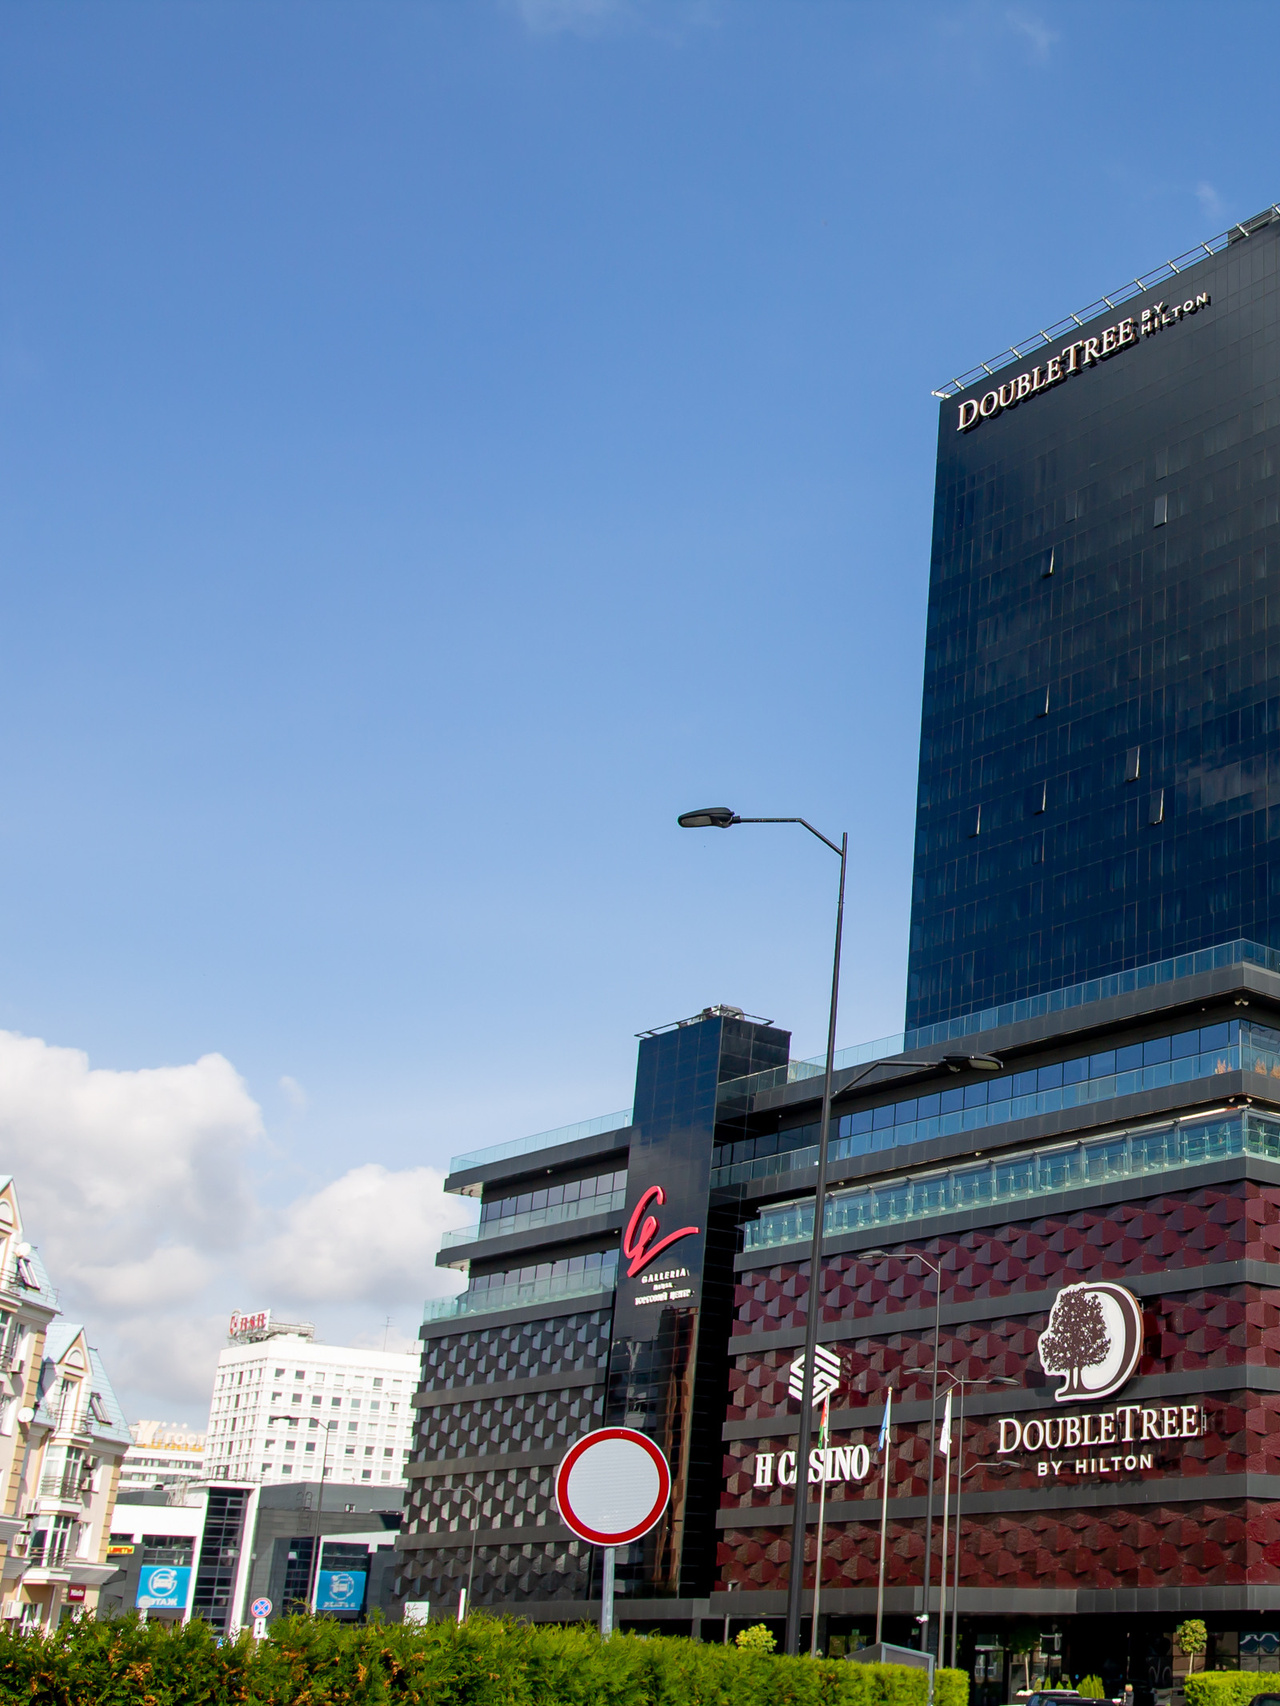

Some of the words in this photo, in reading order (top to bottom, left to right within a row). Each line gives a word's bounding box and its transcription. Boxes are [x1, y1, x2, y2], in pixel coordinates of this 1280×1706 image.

[1141, 301, 1165, 322] BY
[1141, 292, 1207, 335] HILTON
[641, 1267, 687, 1284] GALLERIA
[753, 1453, 775, 1487] H
[778, 1444, 870, 1486] CSINO
[1037, 1460, 1063, 1476] BY
[1075, 1454, 1153, 1474] HILTON
